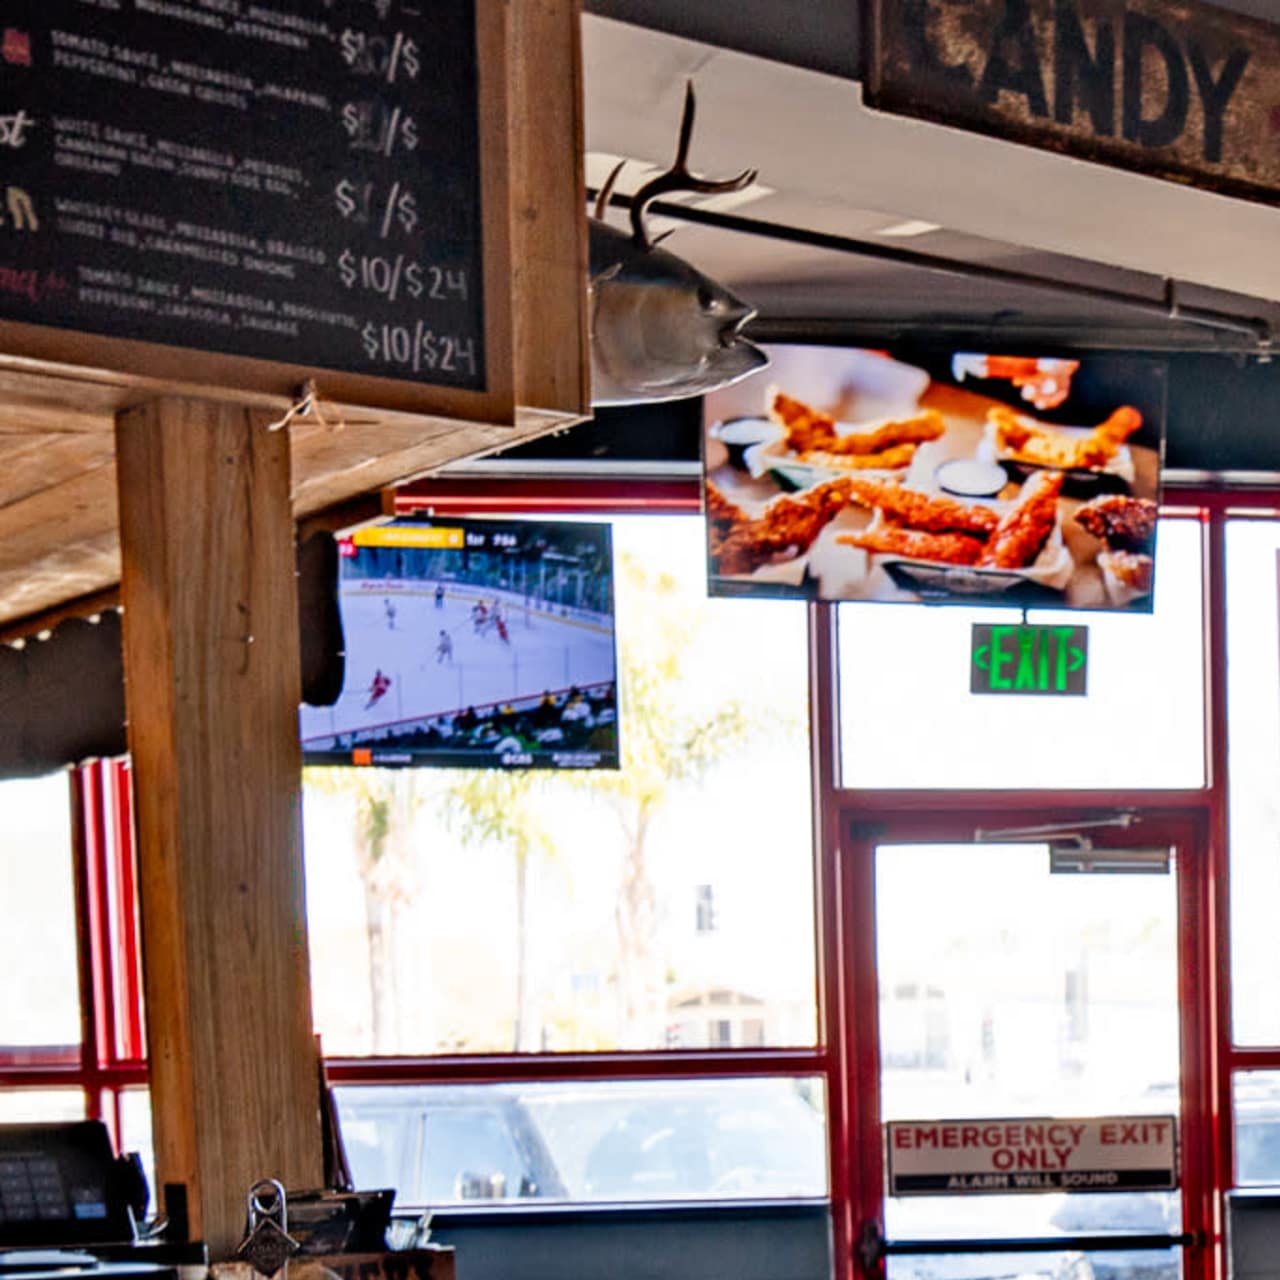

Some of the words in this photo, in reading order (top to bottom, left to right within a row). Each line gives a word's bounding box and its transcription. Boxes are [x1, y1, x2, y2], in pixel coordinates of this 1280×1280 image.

[918, 0, 1253, 164] CANDY
[338, 249, 468, 301] $10/$24
[362, 321, 477, 376] $10/$24
[989, 625, 1074, 690] EXIT
[893, 1124, 1087, 1149] EMERGENCY
[1099, 1122, 1171, 1145] EXIT
[991, 1147, 1073, 1171] ONLY
[946, 1174, 1009, 1189] ALARM
[1012, 1173, 1055, 1188] WILL
[1060, 1171, 1119, 1187] SOUND
